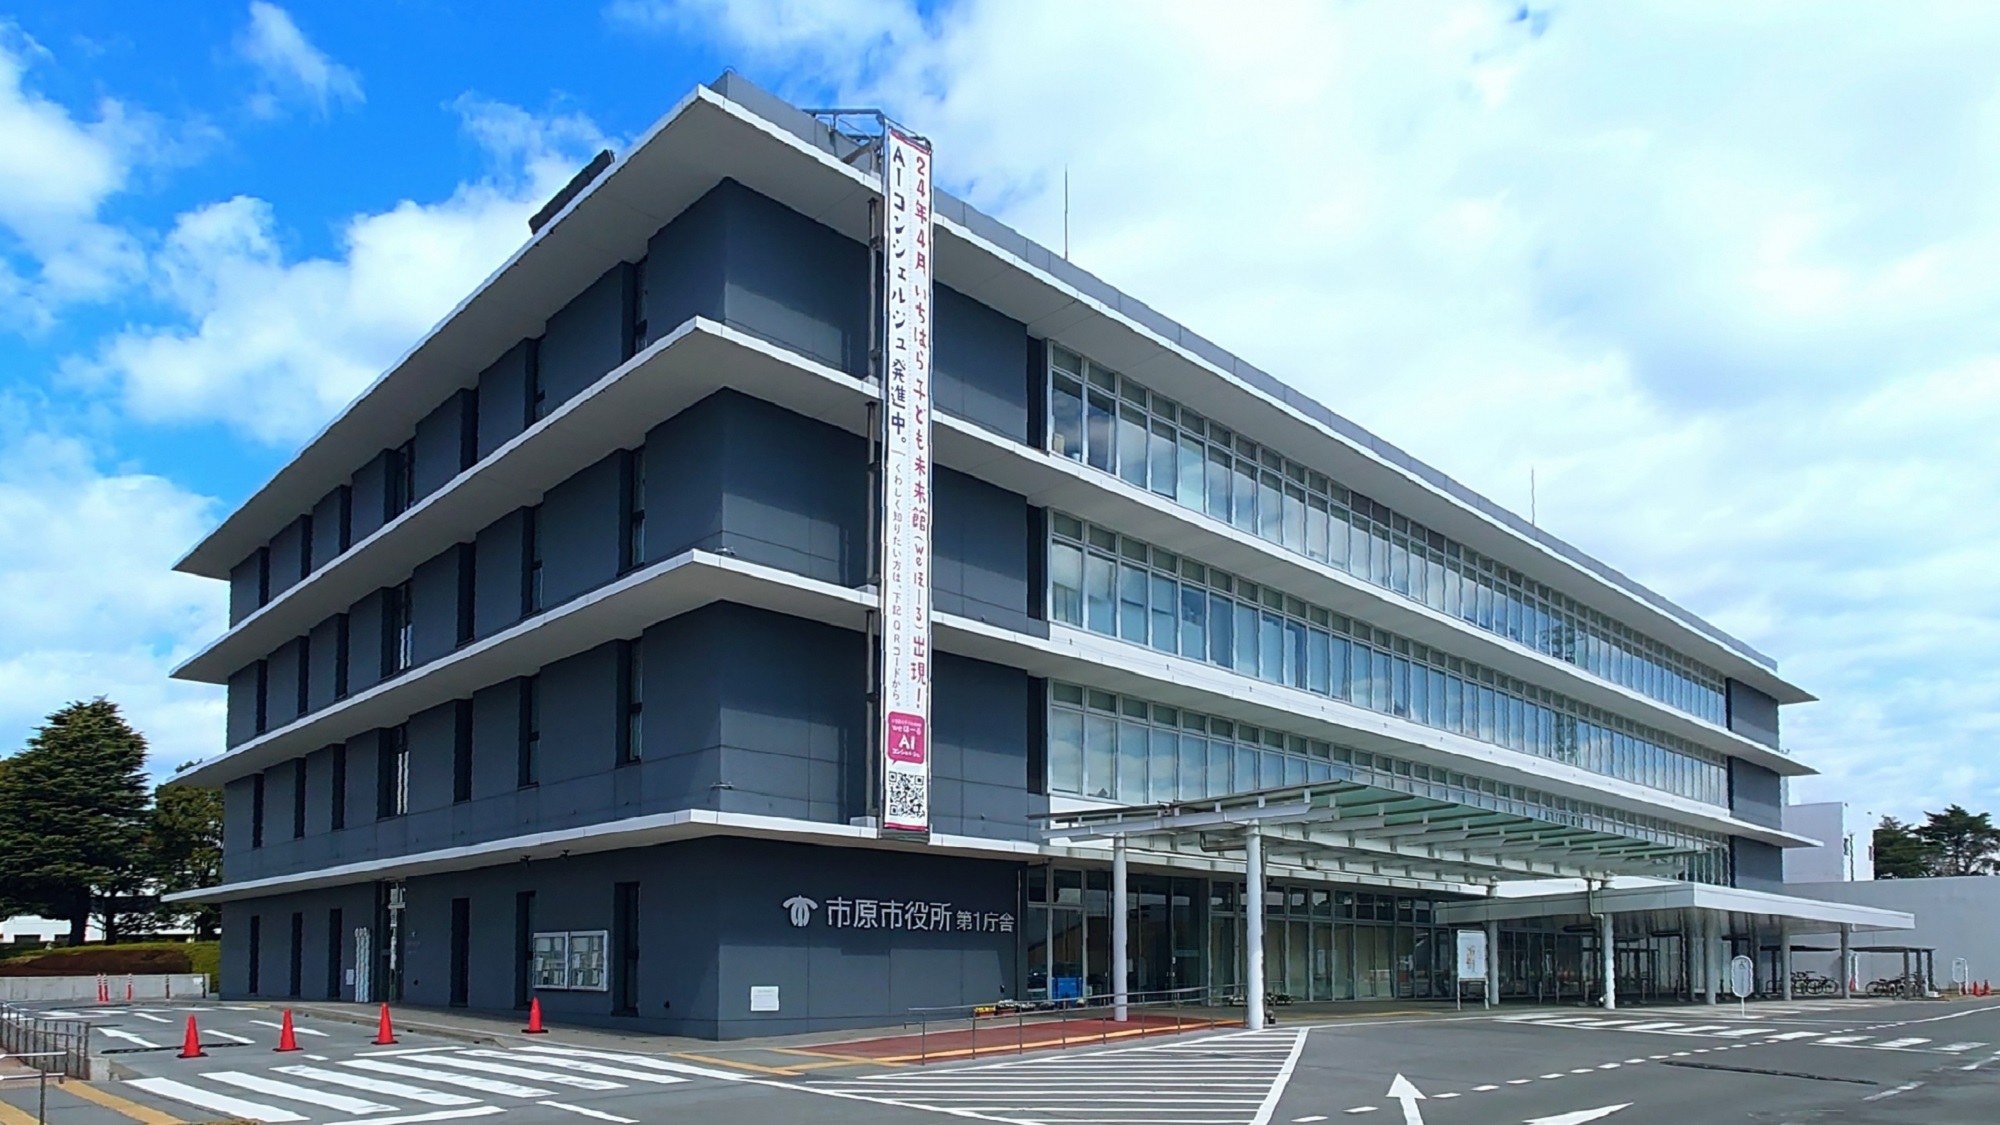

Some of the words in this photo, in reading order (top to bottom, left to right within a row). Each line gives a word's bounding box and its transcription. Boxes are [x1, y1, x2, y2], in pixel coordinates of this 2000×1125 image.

[899, 734, 916, 750] AI
[826, 897, 953, 932] 市原市役所
[956, 910, 1016, 933] 第1庁舎
